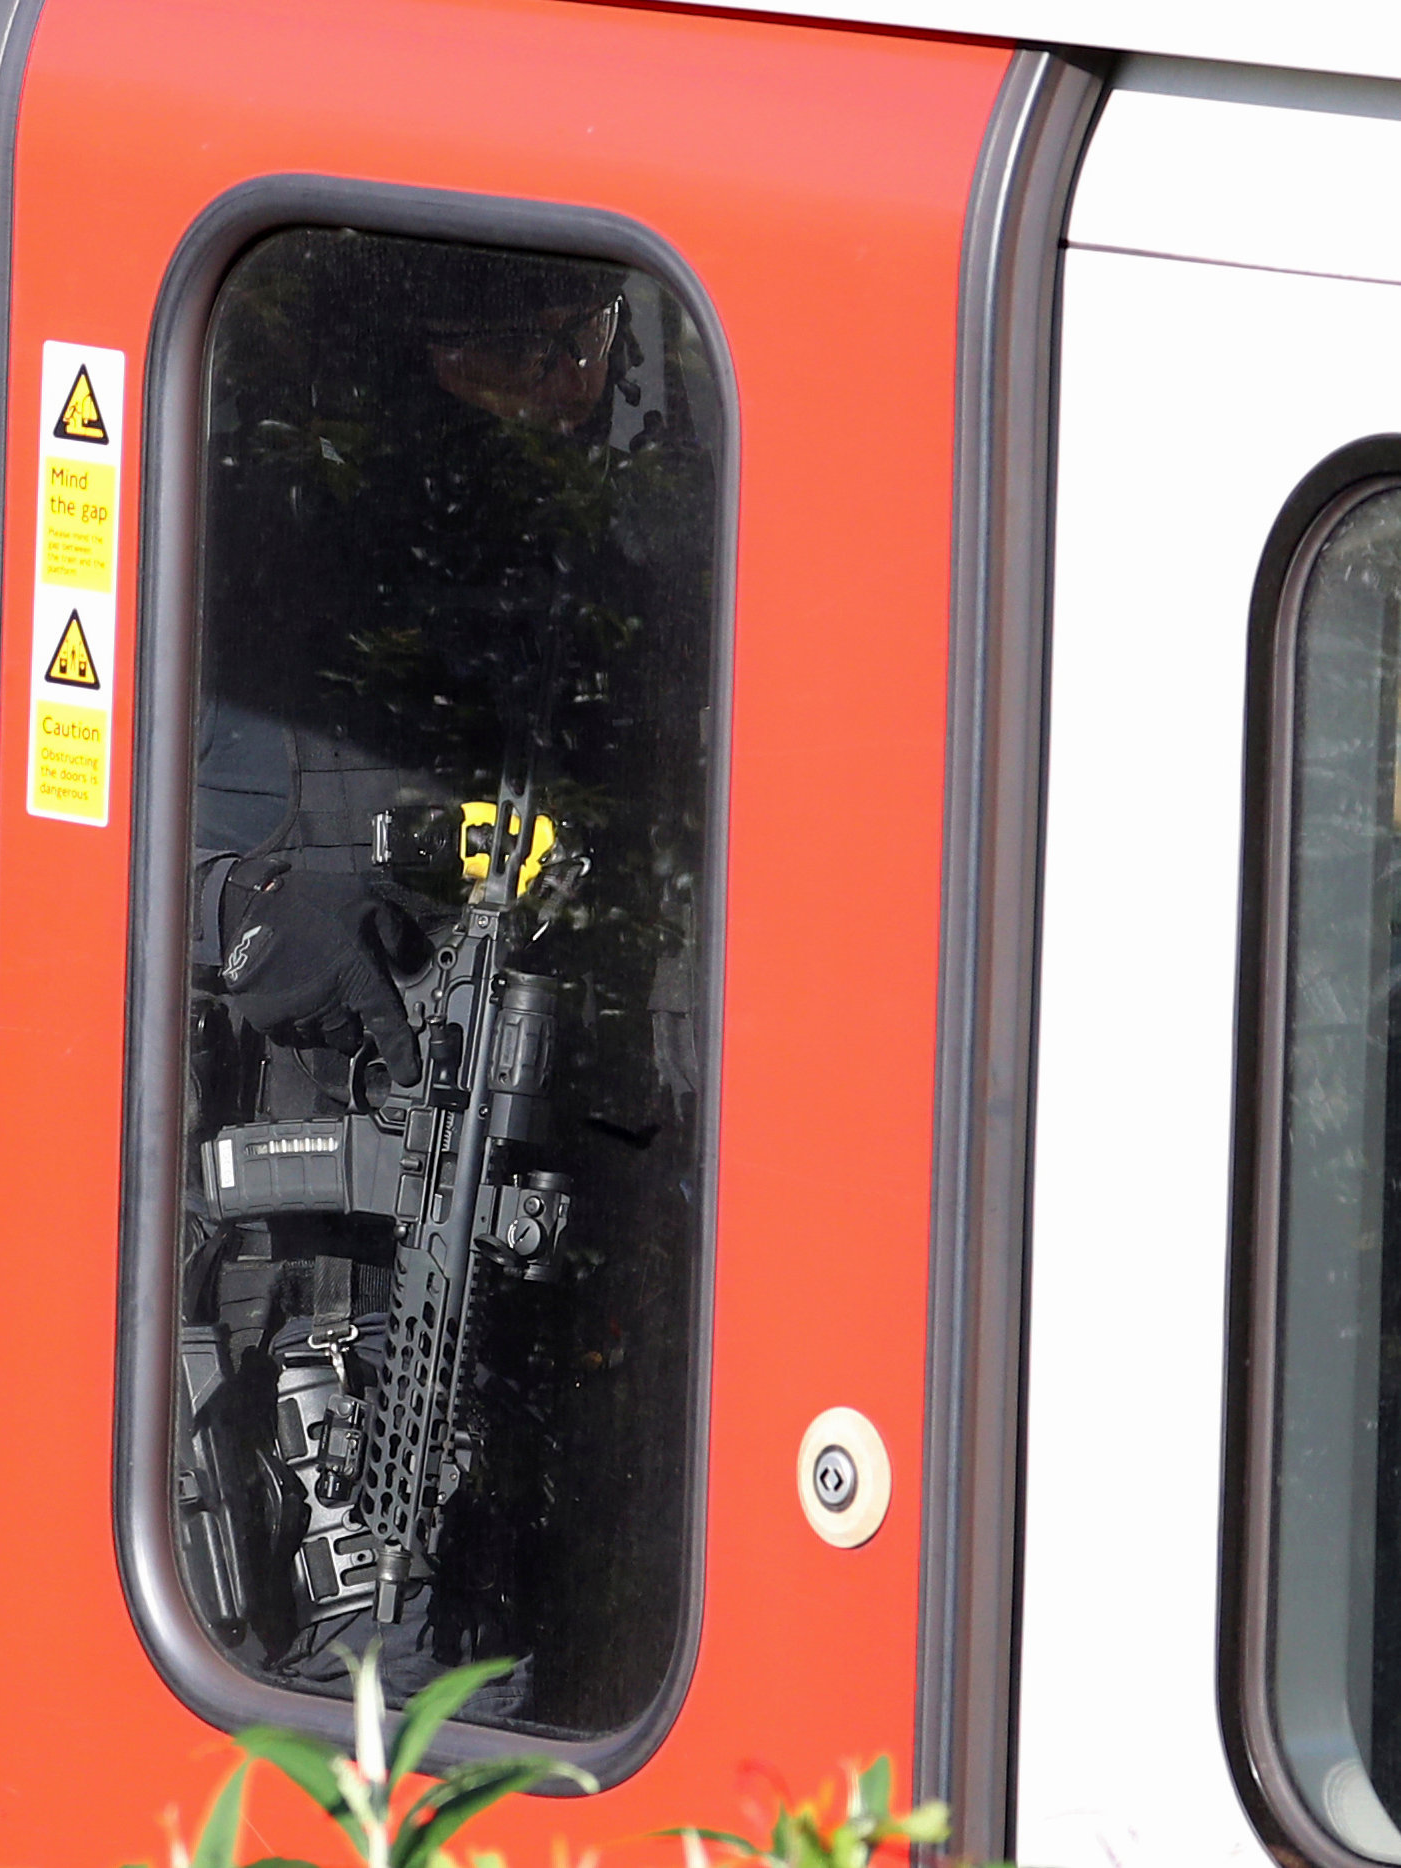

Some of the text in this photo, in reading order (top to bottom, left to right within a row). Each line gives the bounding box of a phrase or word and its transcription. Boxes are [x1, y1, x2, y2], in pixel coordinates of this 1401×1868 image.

[51, 467, 88, 490] Mind
[50, 496, 108, 525] the gap
[42, 716, 100, 742] Caution
[41, 747, 99, 769] Obstructing
[41, 766, 98, 785] the doors is
[40, 783, 88, 800] dangerous
